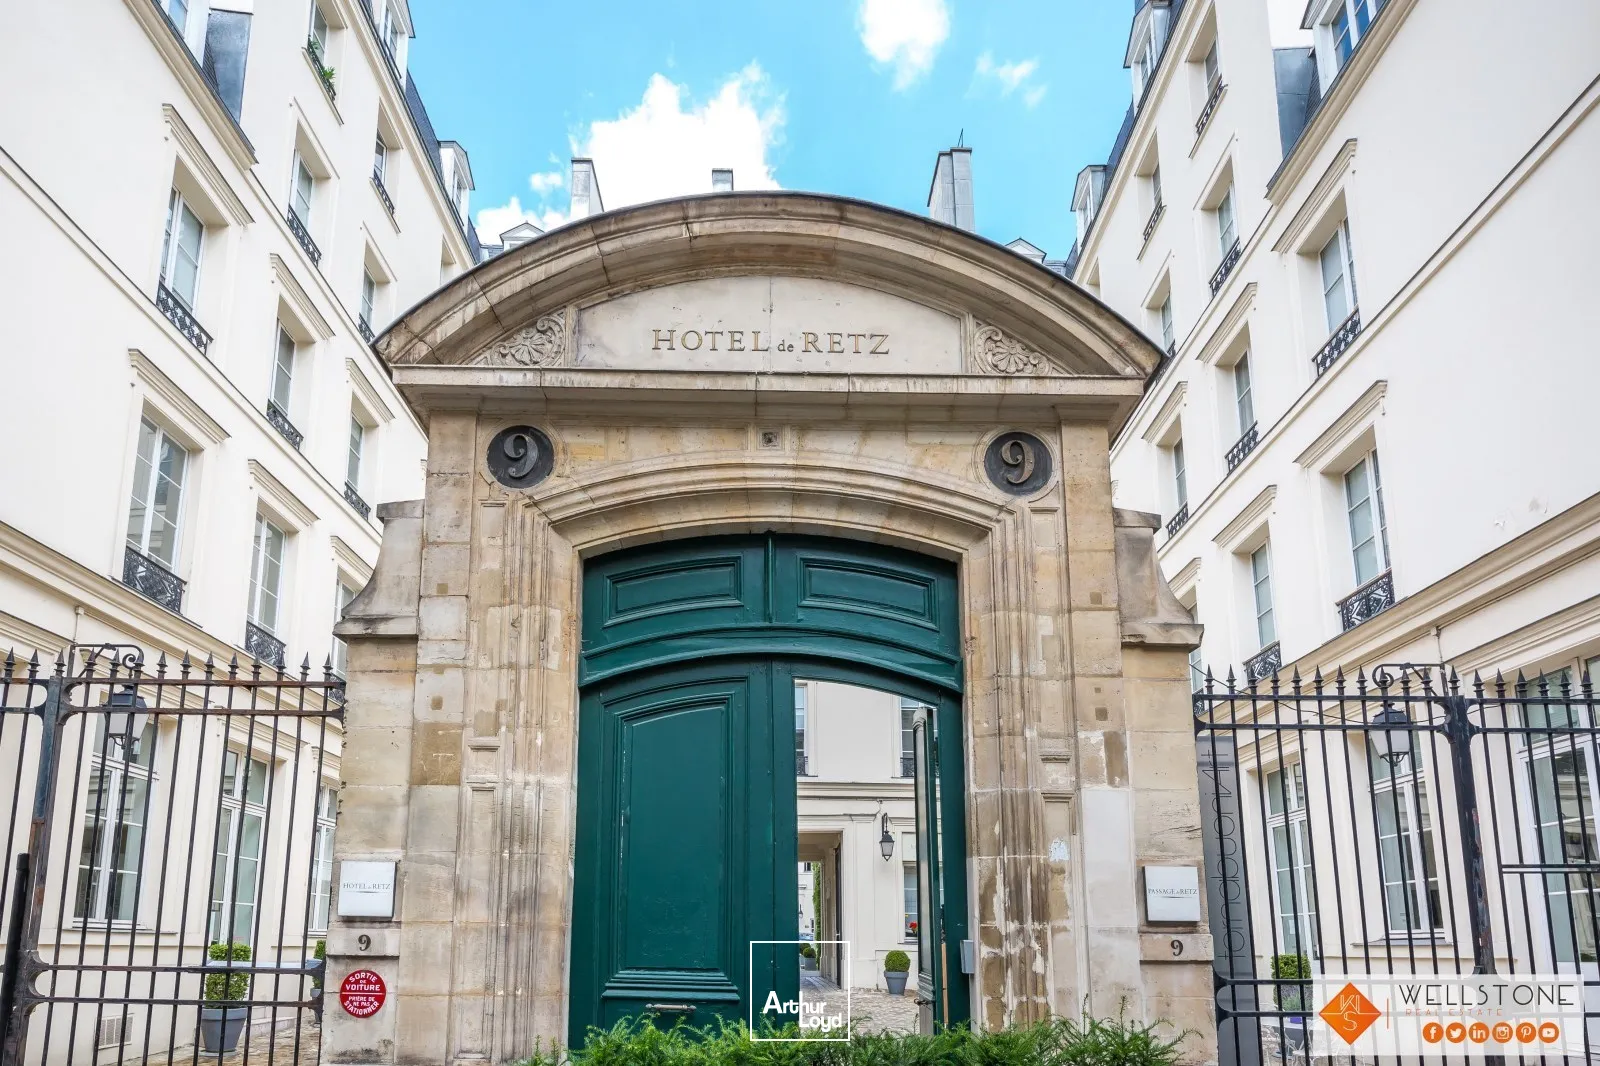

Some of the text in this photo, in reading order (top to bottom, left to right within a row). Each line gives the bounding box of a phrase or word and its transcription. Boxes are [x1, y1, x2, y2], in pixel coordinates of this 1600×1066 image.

[652, 329, 890, 355] HOTEL de RETZ
[503, 433, 538, 478] 9
[1001, 440, 1034, 484] 9
[358, 934, 371, 951] 9
[1170, 939, 1184, 956] 9
[349, 972, 378, 983] SORTIE
[344, 1000, 380, 1015] STATIONNER
